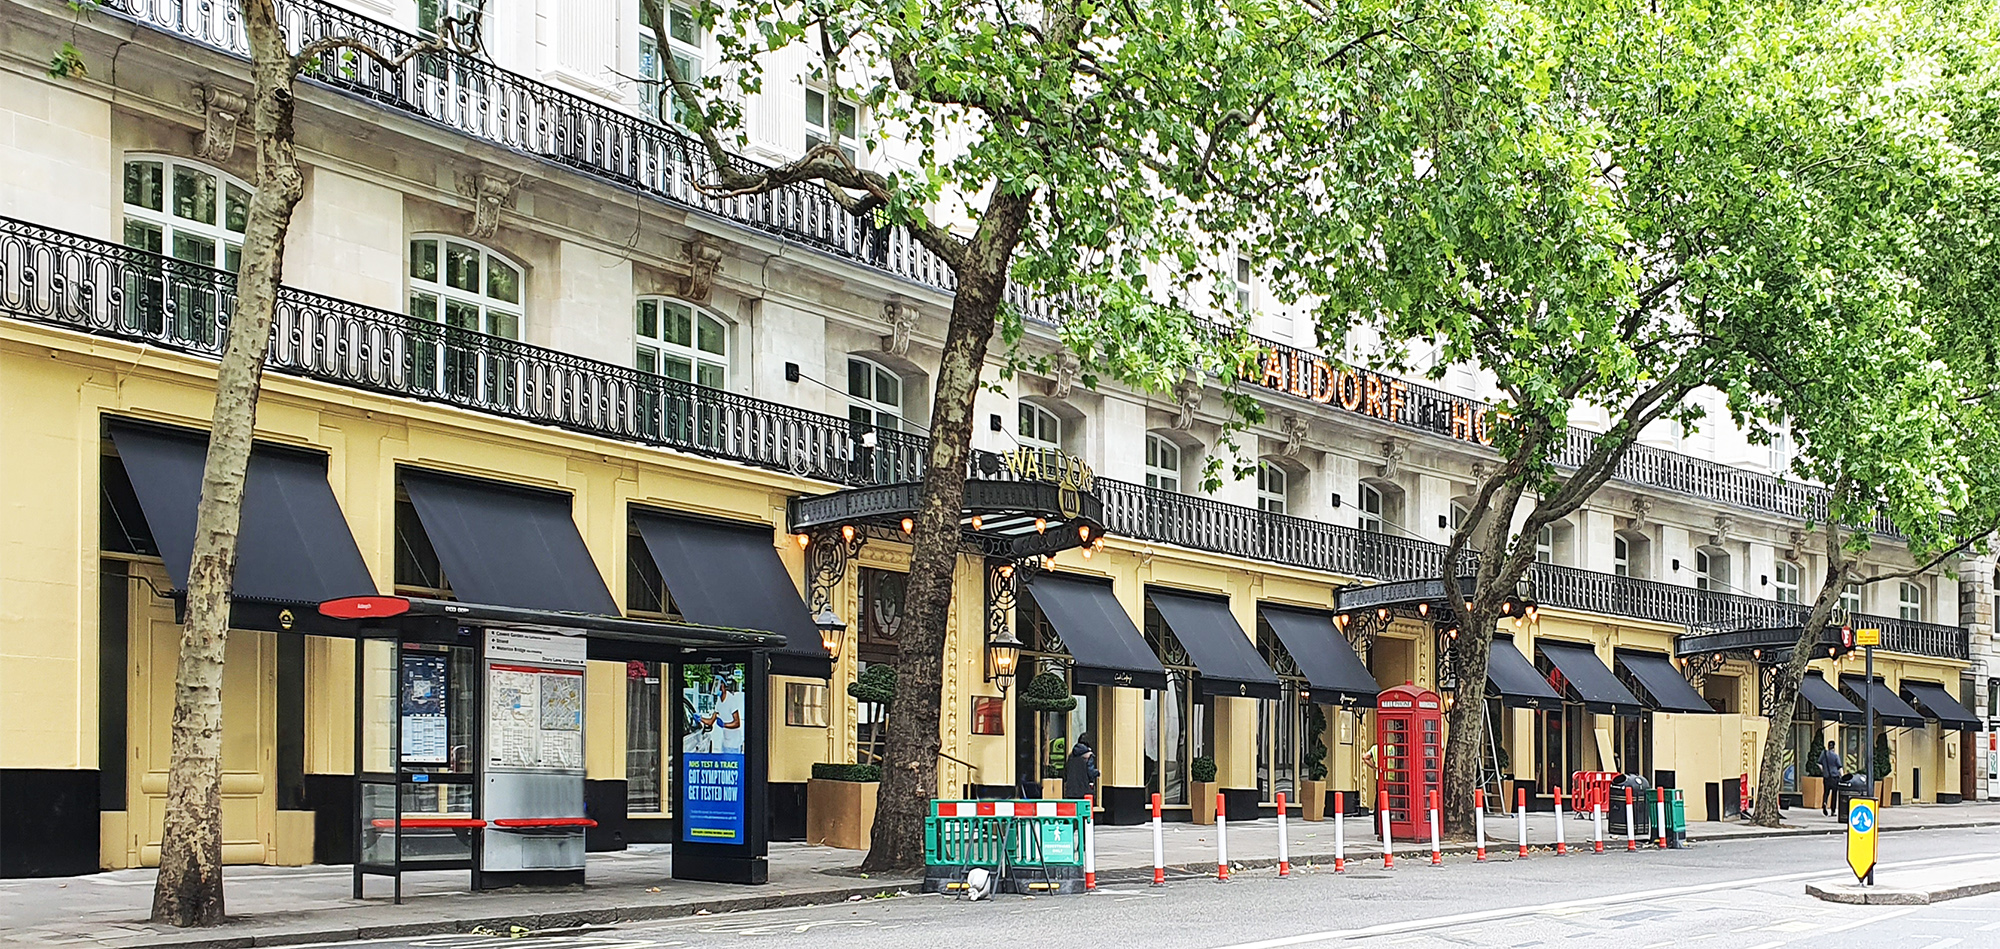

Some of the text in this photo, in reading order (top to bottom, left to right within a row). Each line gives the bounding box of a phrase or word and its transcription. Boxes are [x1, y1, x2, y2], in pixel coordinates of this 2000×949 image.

[721, 761, 738, 769] TRACE
[688, 769, 739, 786] GOT SYMPTOMS?
[688, 785, 738, 802] GET TESTED NOW
